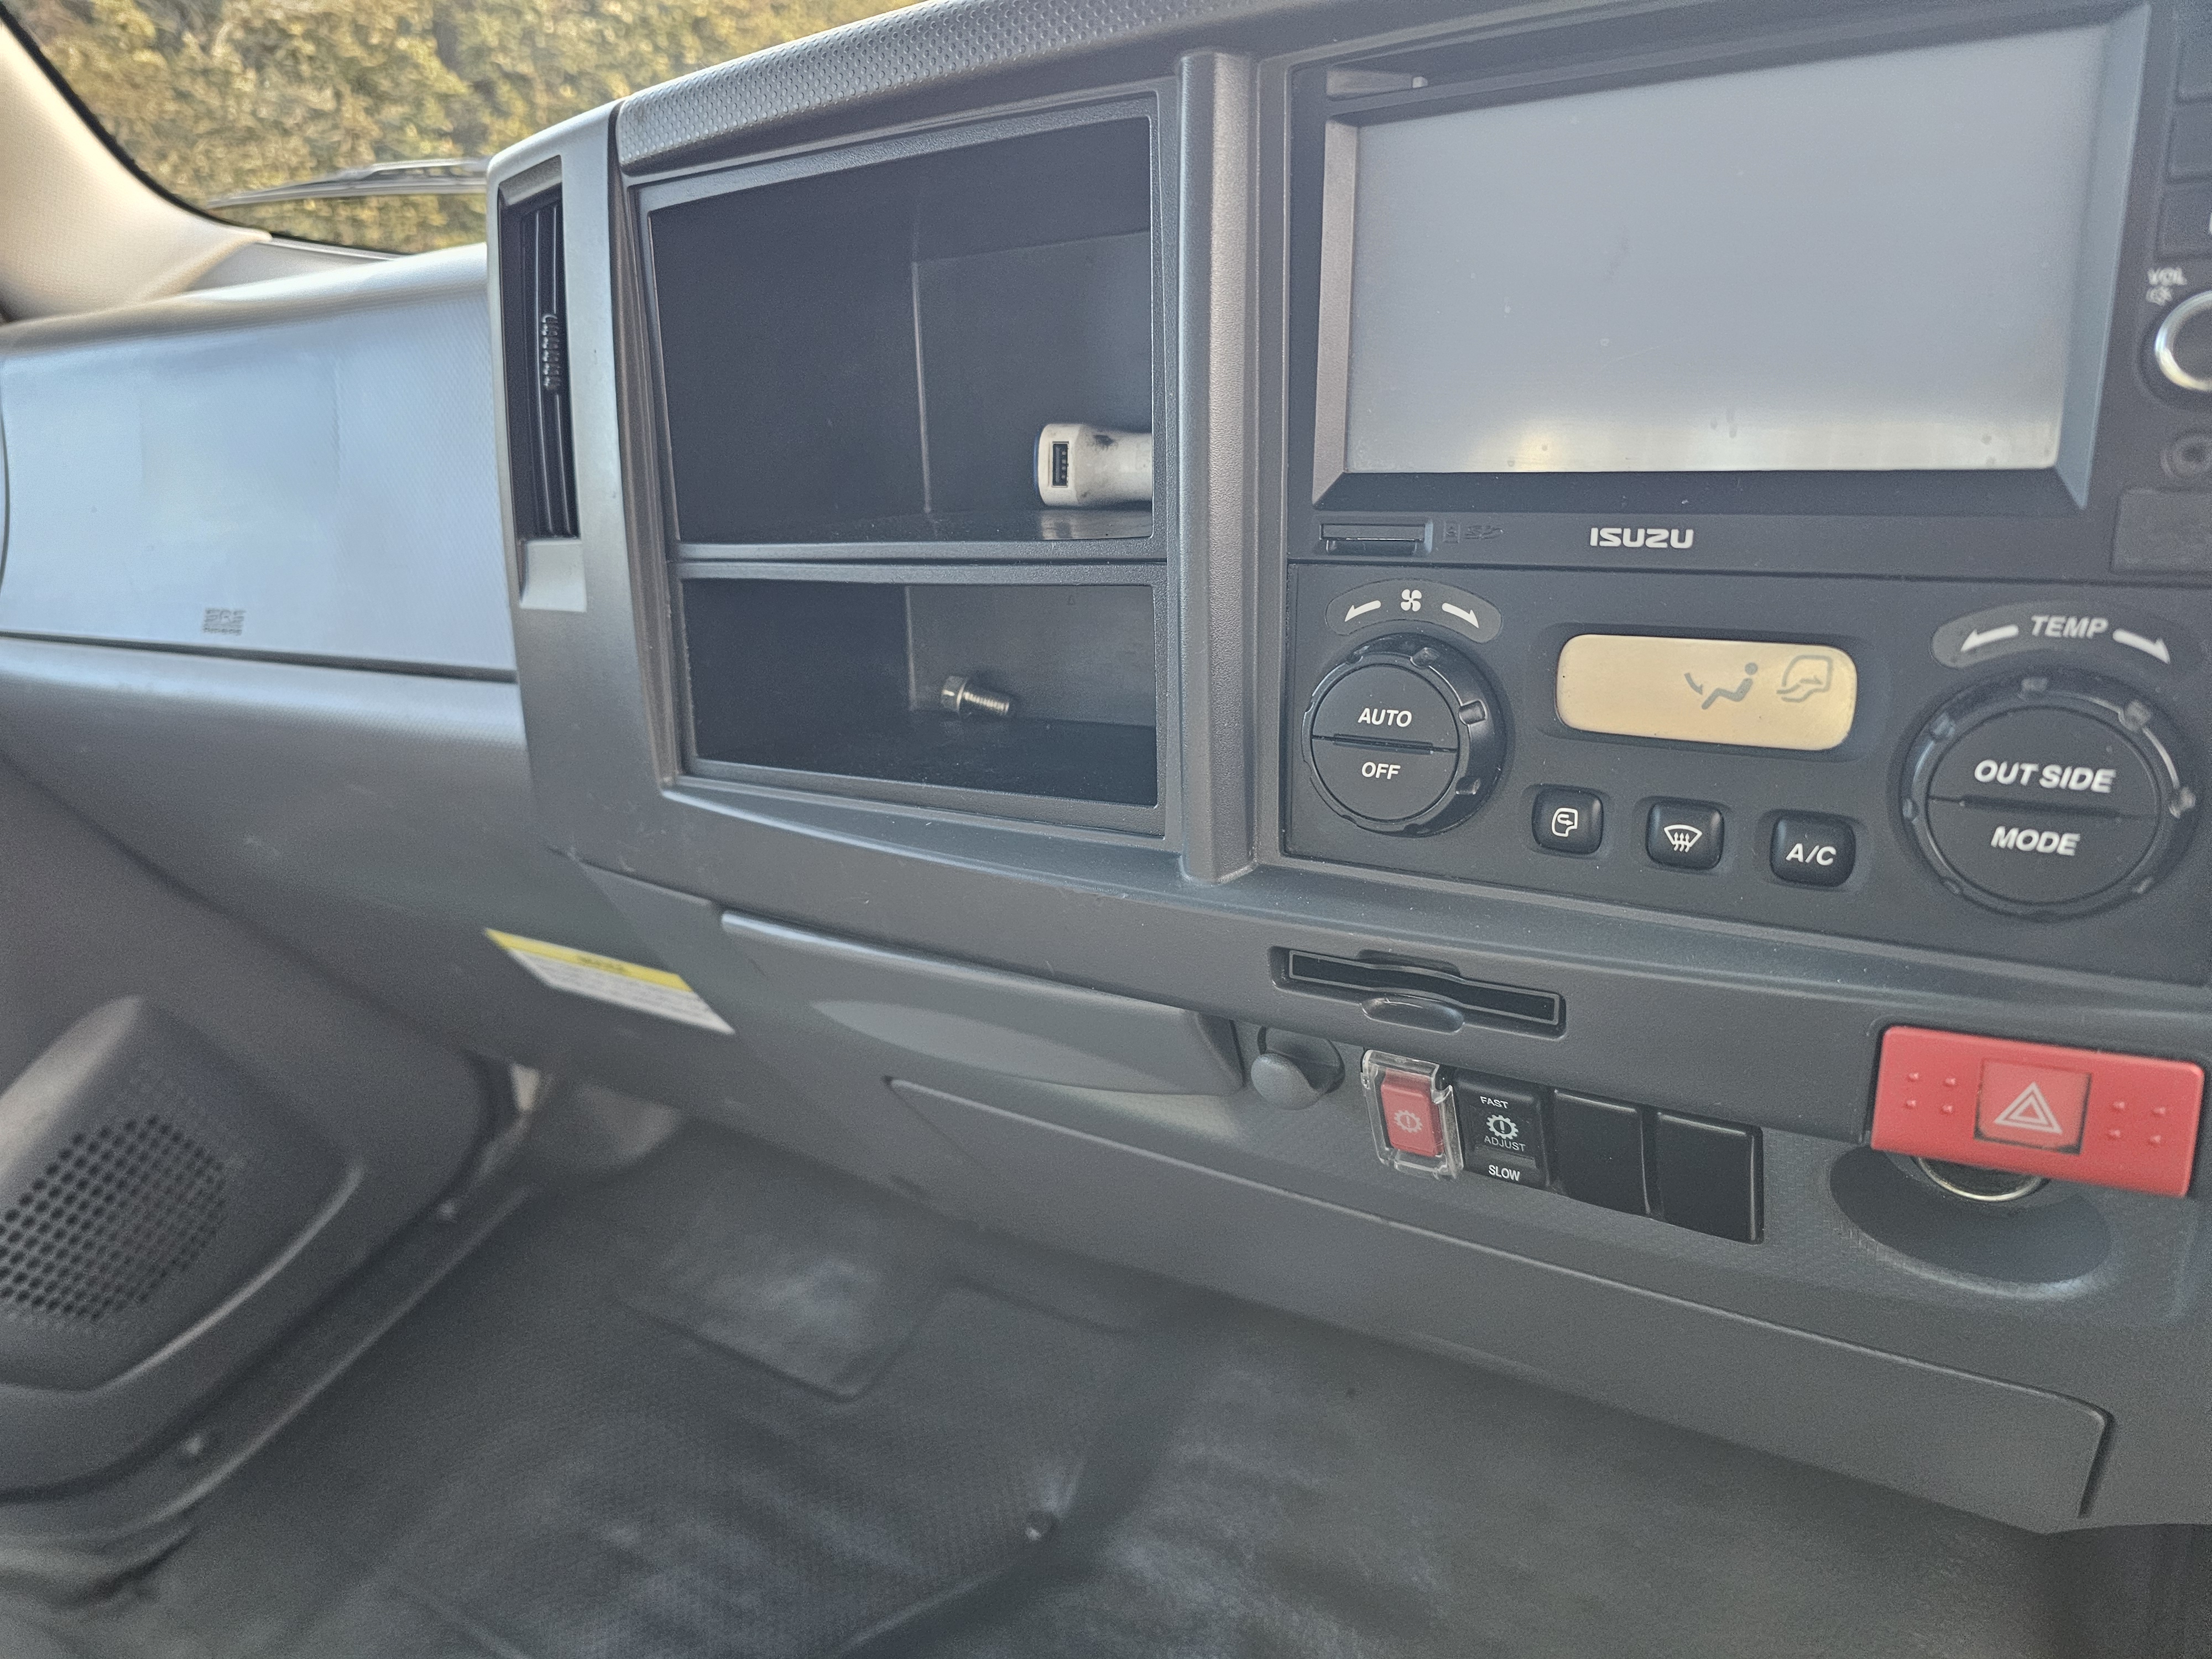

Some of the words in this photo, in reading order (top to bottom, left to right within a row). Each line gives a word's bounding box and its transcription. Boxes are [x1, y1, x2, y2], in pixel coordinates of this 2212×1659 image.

[1589, 527, 1694, 549] ISUZU
[2030, 614, 2108, 638] TEMP
[1357, 707, 1412, 727] AUTO
[1361, 761, 1401, 780] OFF
[1991, 826, 2080, 855] MODE
[1786, 842, 1836, 866] A/C
[1480, 1095, 1509, 1109] FAST
[1484, 1135, 1526, 1152] ADJUST
[1488, 1164, 1520, 1181] SLOW
